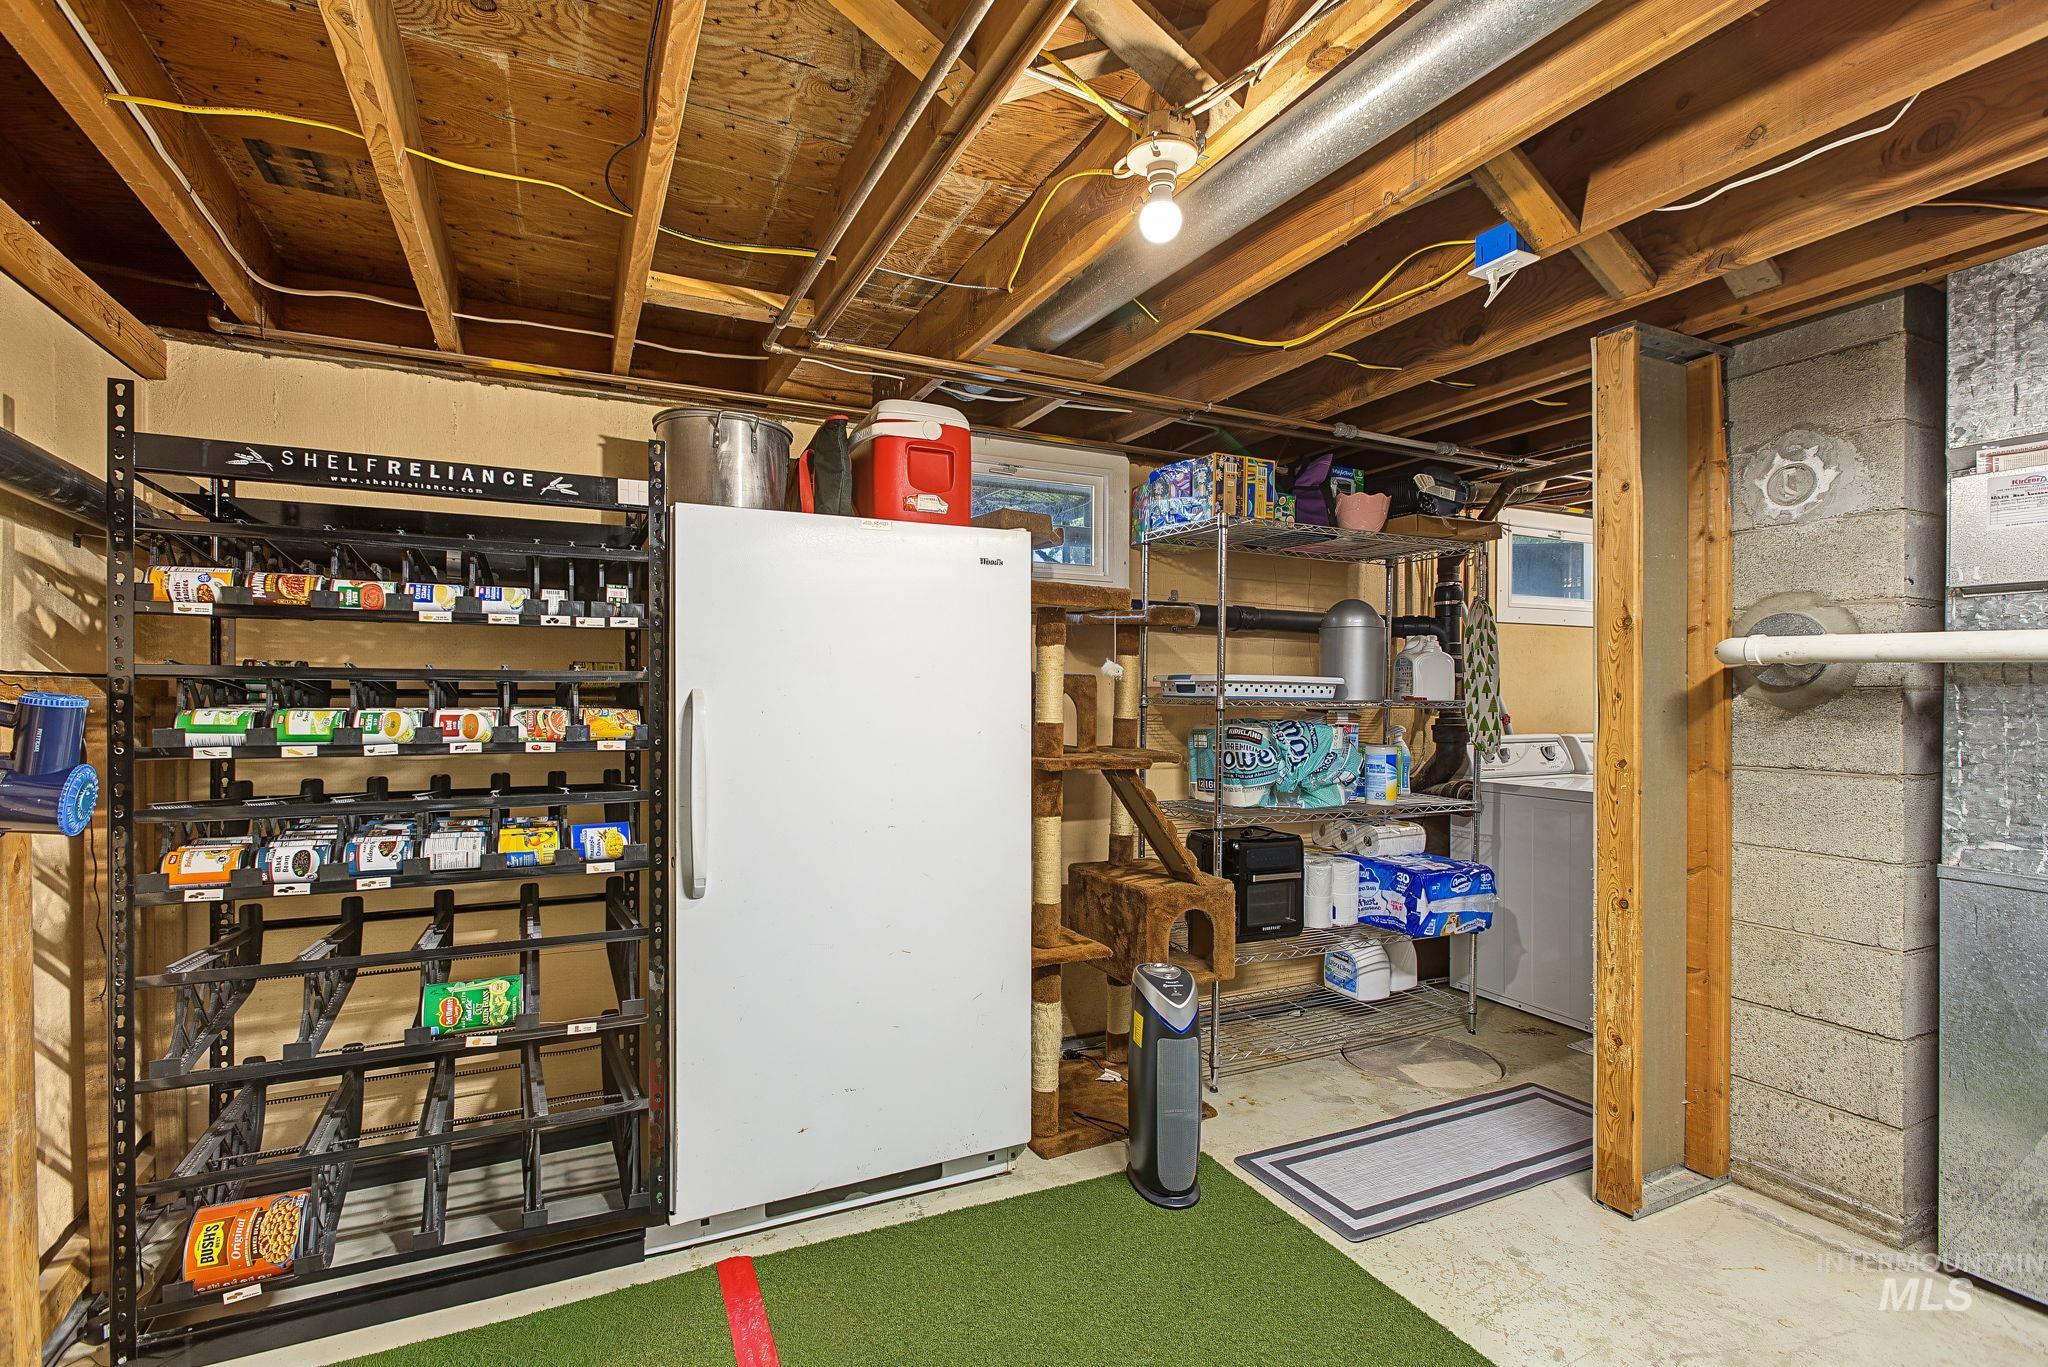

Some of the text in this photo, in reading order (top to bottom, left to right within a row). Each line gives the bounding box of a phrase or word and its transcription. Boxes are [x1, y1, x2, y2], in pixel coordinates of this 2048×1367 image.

[281, 450, 534, 487] SHELFRELIANCE
[330, 475, 484, 495] www.shelfreliance.com
[1396, 871, 1410, 884] 30
[1480, 873, 1492, 882] 30
[200, 1224, 220, 1264] BUSH'S
[231, 1217, 246, 1260] Original
